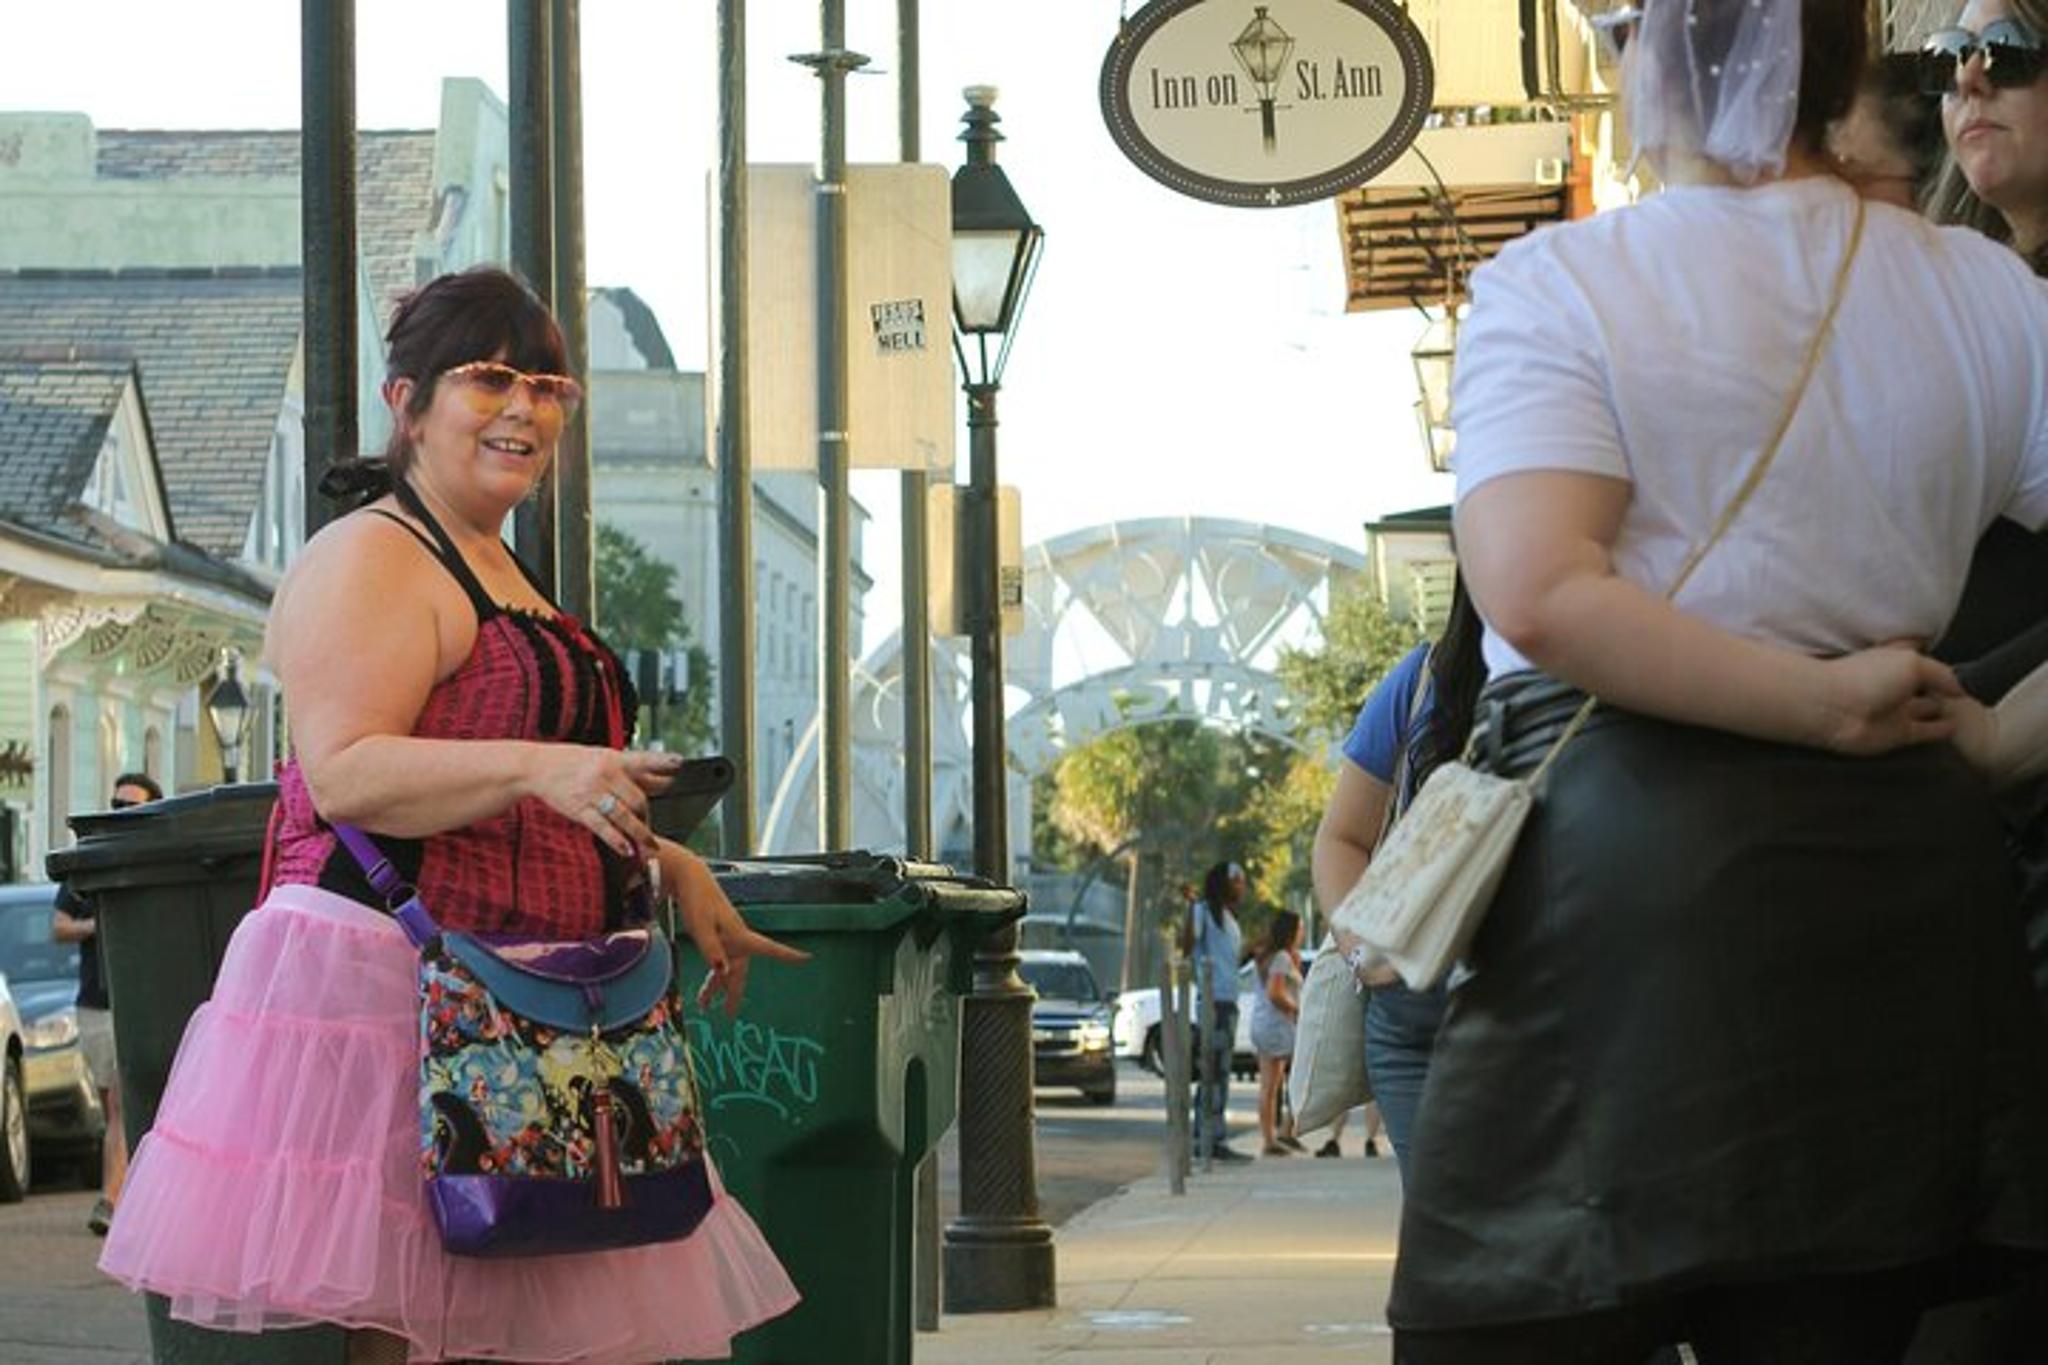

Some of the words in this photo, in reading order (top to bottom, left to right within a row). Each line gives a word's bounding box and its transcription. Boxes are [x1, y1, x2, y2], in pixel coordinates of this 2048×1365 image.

[1151, 67, 1198, 108] Inn
[1207, 74, 1238, 106] on
[1296, 59, 1327, 100] St.
[1333, 56, 1382, 98] Ann
